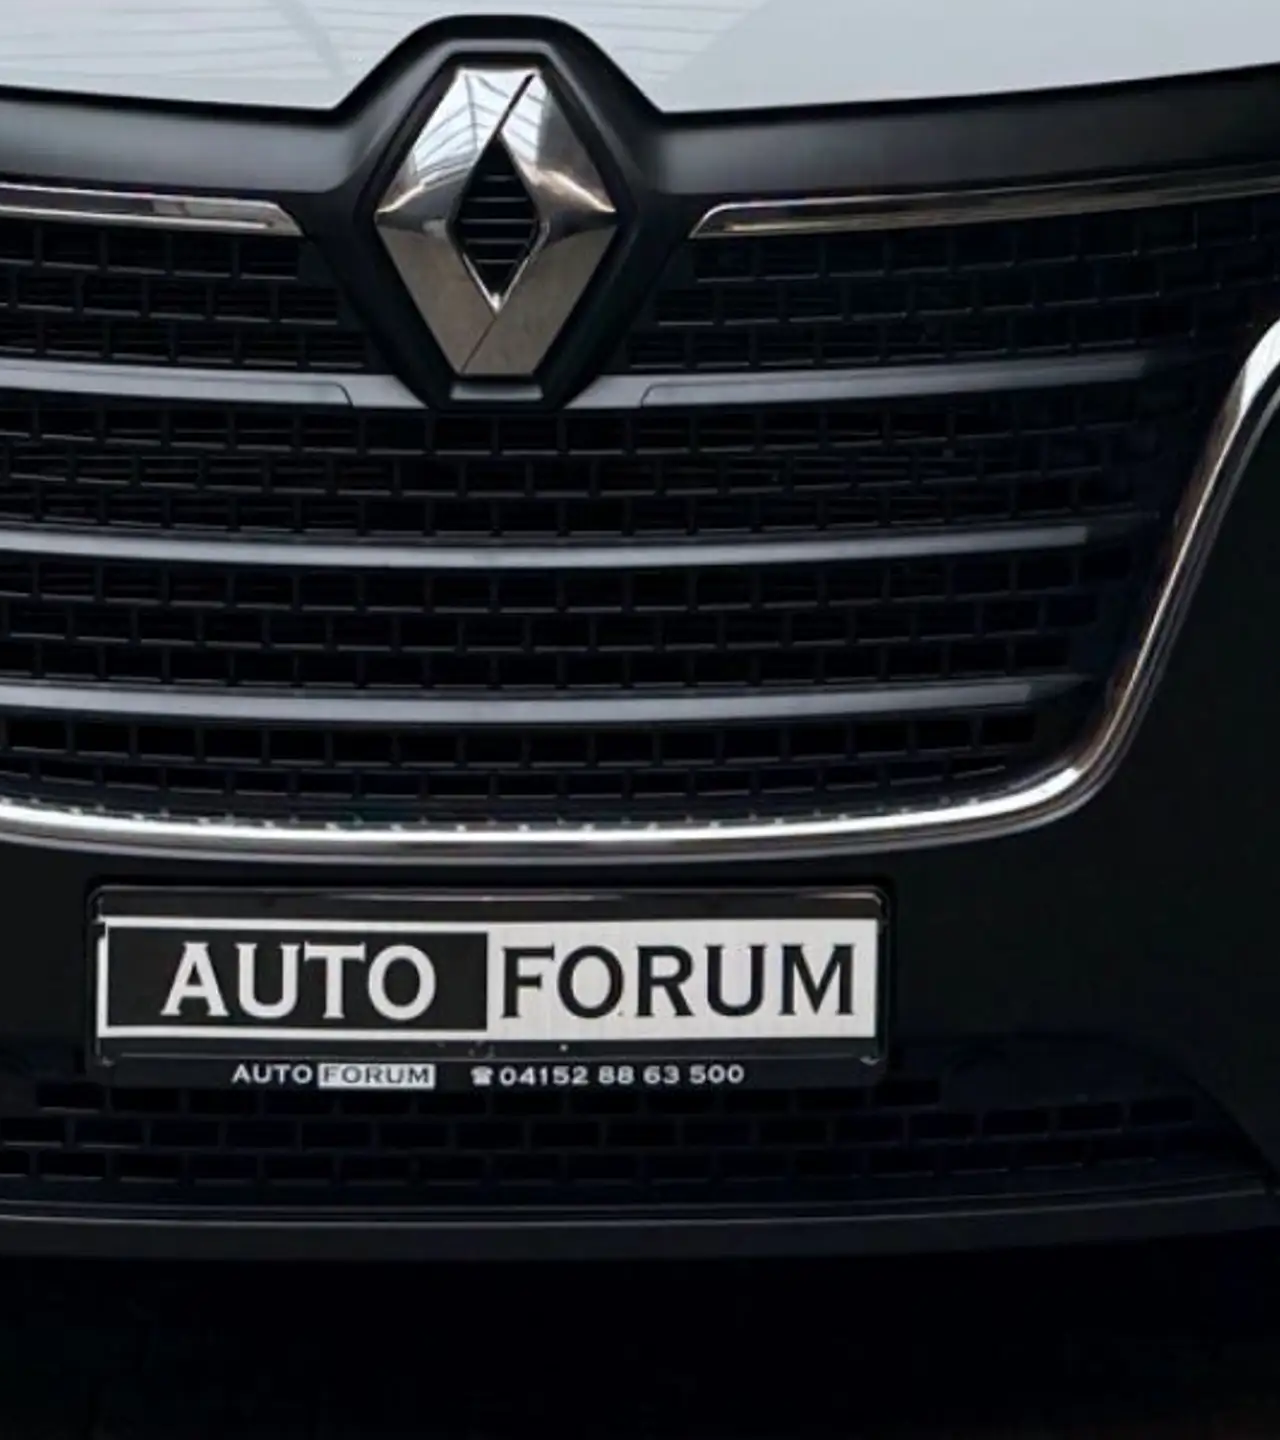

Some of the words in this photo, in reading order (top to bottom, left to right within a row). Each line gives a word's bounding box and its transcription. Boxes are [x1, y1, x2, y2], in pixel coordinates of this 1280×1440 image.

[161, 941, 436, 1020] AUTO
[501, 943, 855, 1019] FORUM
[231, 1063, 313, 1084] AUTO
[322, 1065, 431, 1085] FORUM
[499, 1065, 589, 1086] 04152
[598, 1065, 635, 1085] 88
[643, 1065, 680, 1085] 63
[690, 1064, 745, 1085] 500
